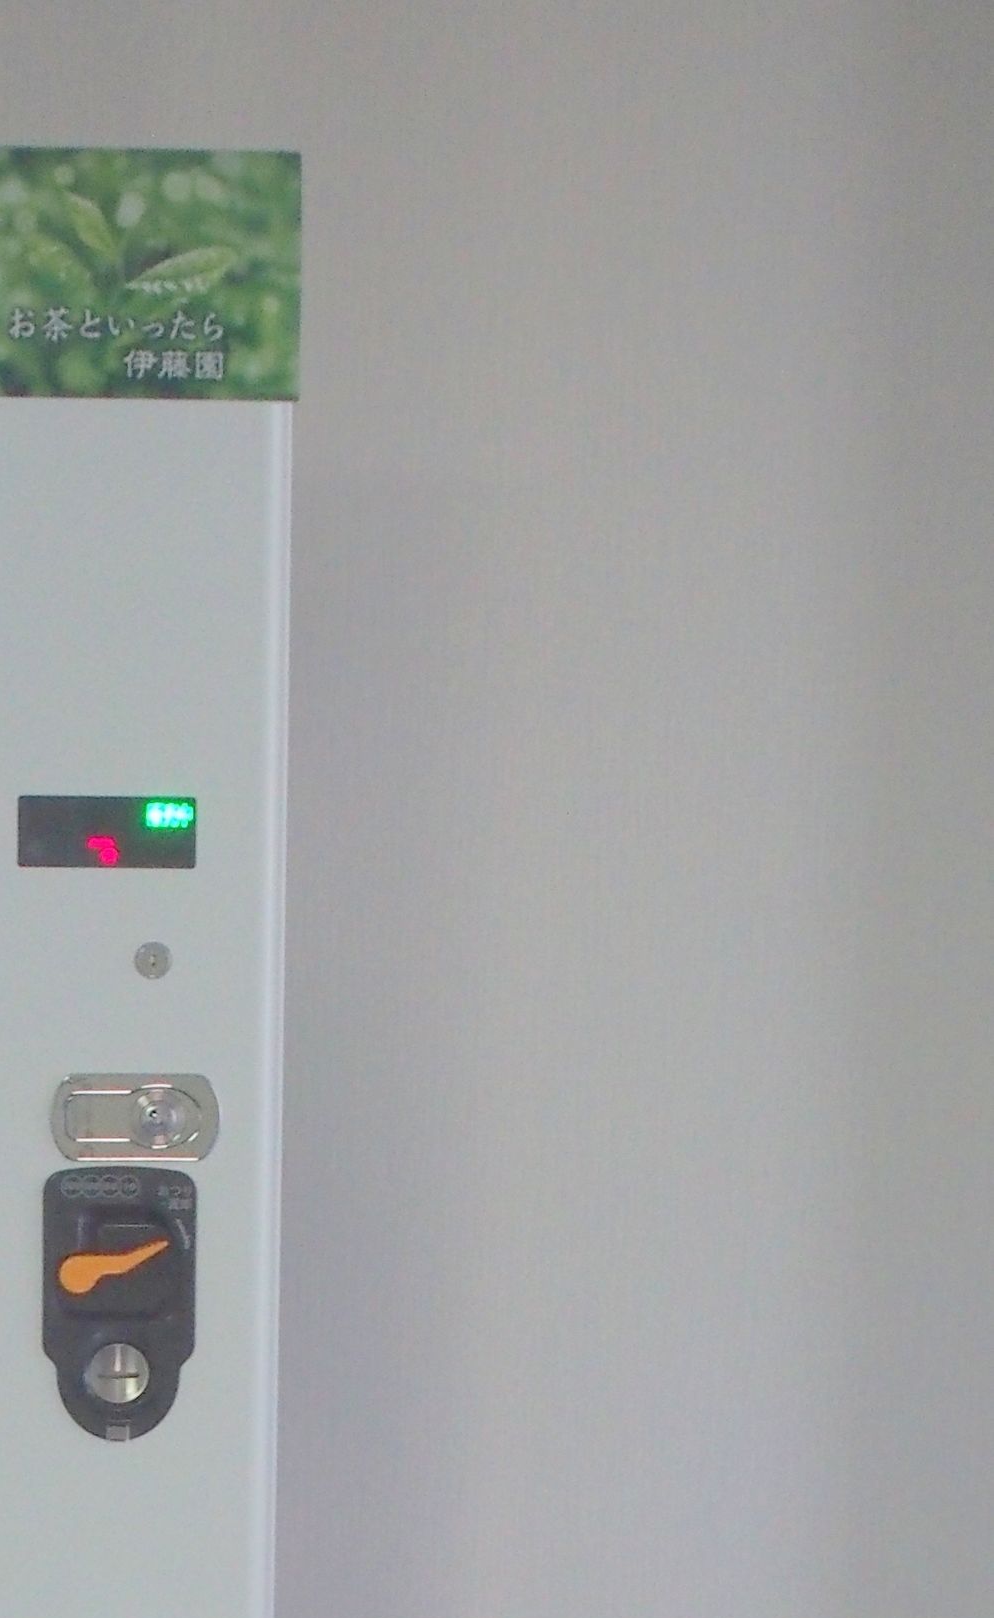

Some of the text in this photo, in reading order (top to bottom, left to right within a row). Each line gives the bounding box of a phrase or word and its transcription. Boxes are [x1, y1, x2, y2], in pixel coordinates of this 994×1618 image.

[9, 309, 225, 343] お茶といったら
[124, 350, 225, 380] 伊藤園
